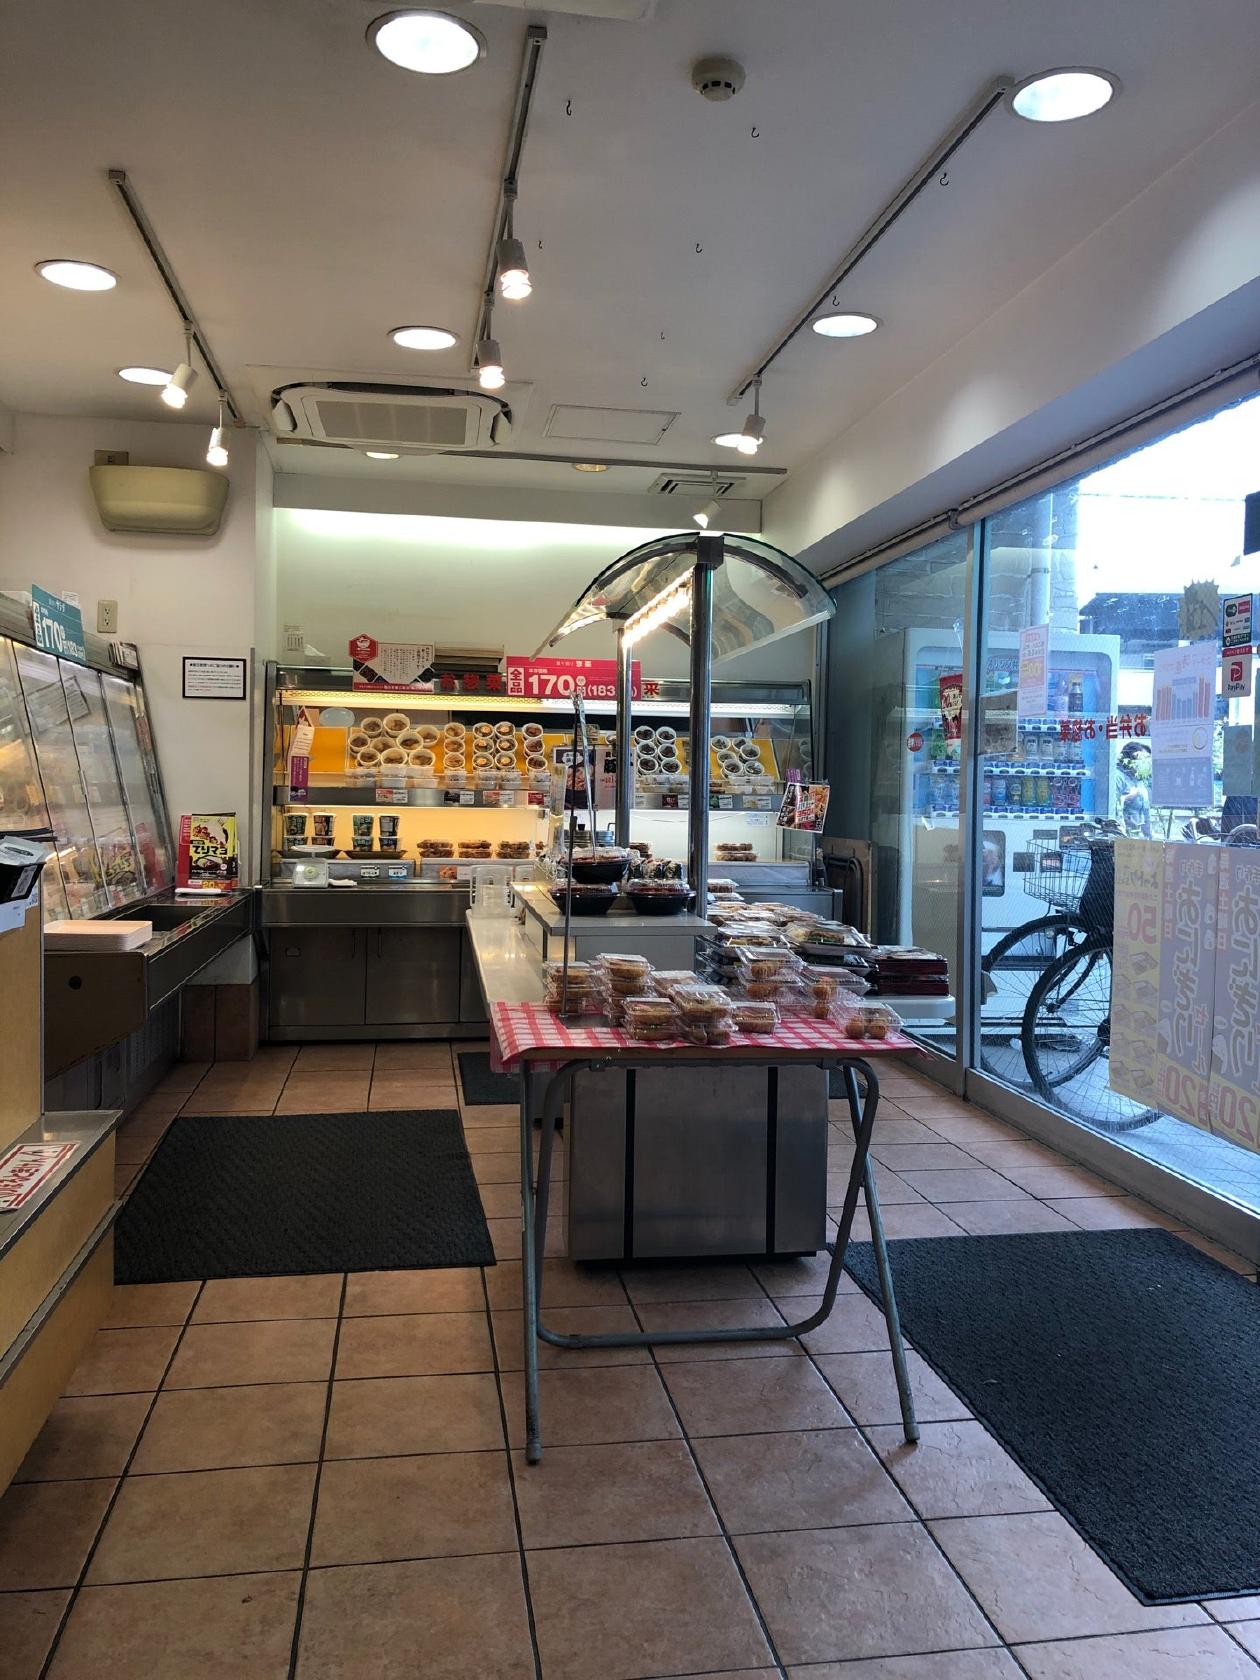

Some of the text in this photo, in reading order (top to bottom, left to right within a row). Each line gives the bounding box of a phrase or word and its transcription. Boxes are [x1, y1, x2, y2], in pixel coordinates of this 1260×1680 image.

[510, 668, 523, 694] 全品
[192, 845, 228, 856] てりマヨ
